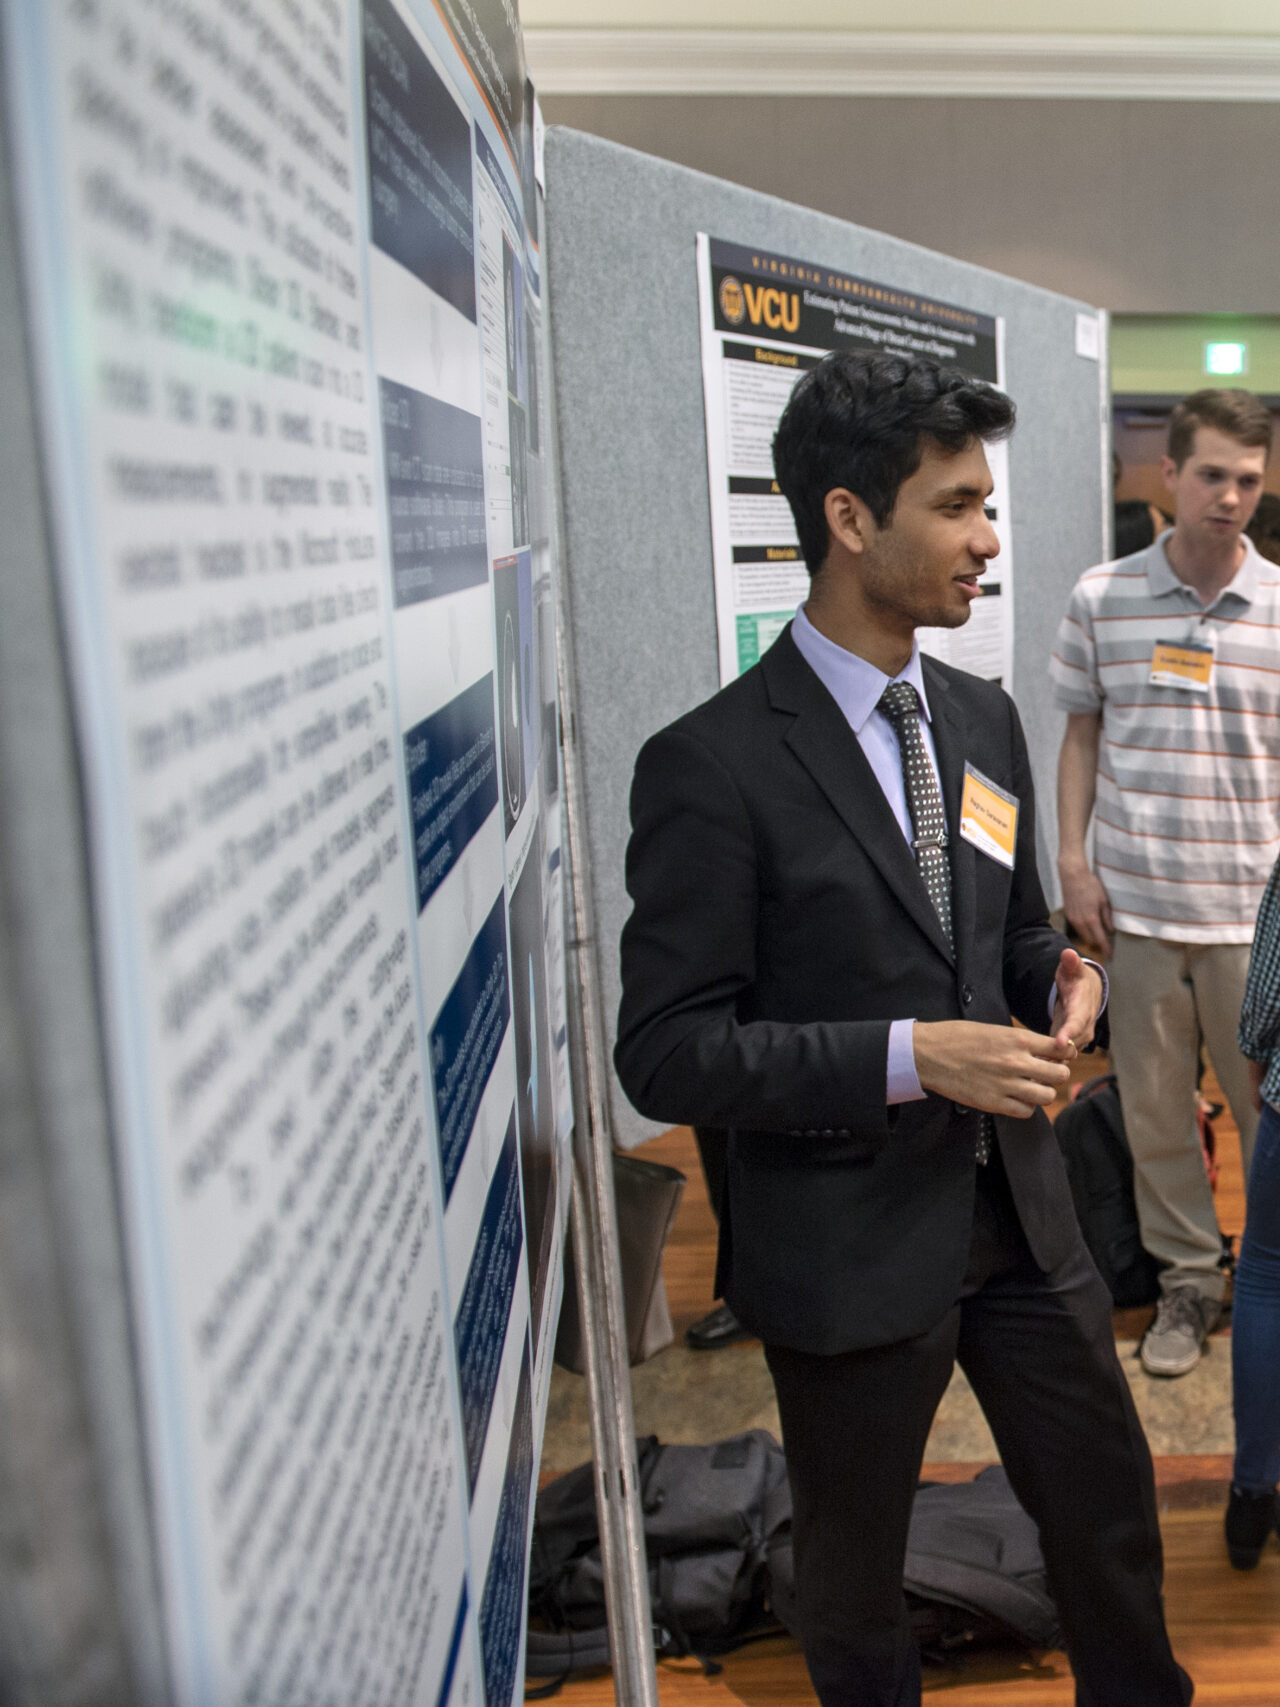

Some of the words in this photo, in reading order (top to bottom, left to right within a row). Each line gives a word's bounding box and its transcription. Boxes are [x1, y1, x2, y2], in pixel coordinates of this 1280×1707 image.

[743, 283, 800, 333] VCU
[752, 256, 821, 284] VIRGINIA
[828, 275, 915, 310] COMMONWEALTH
[755, 347, 799, 367] Background
